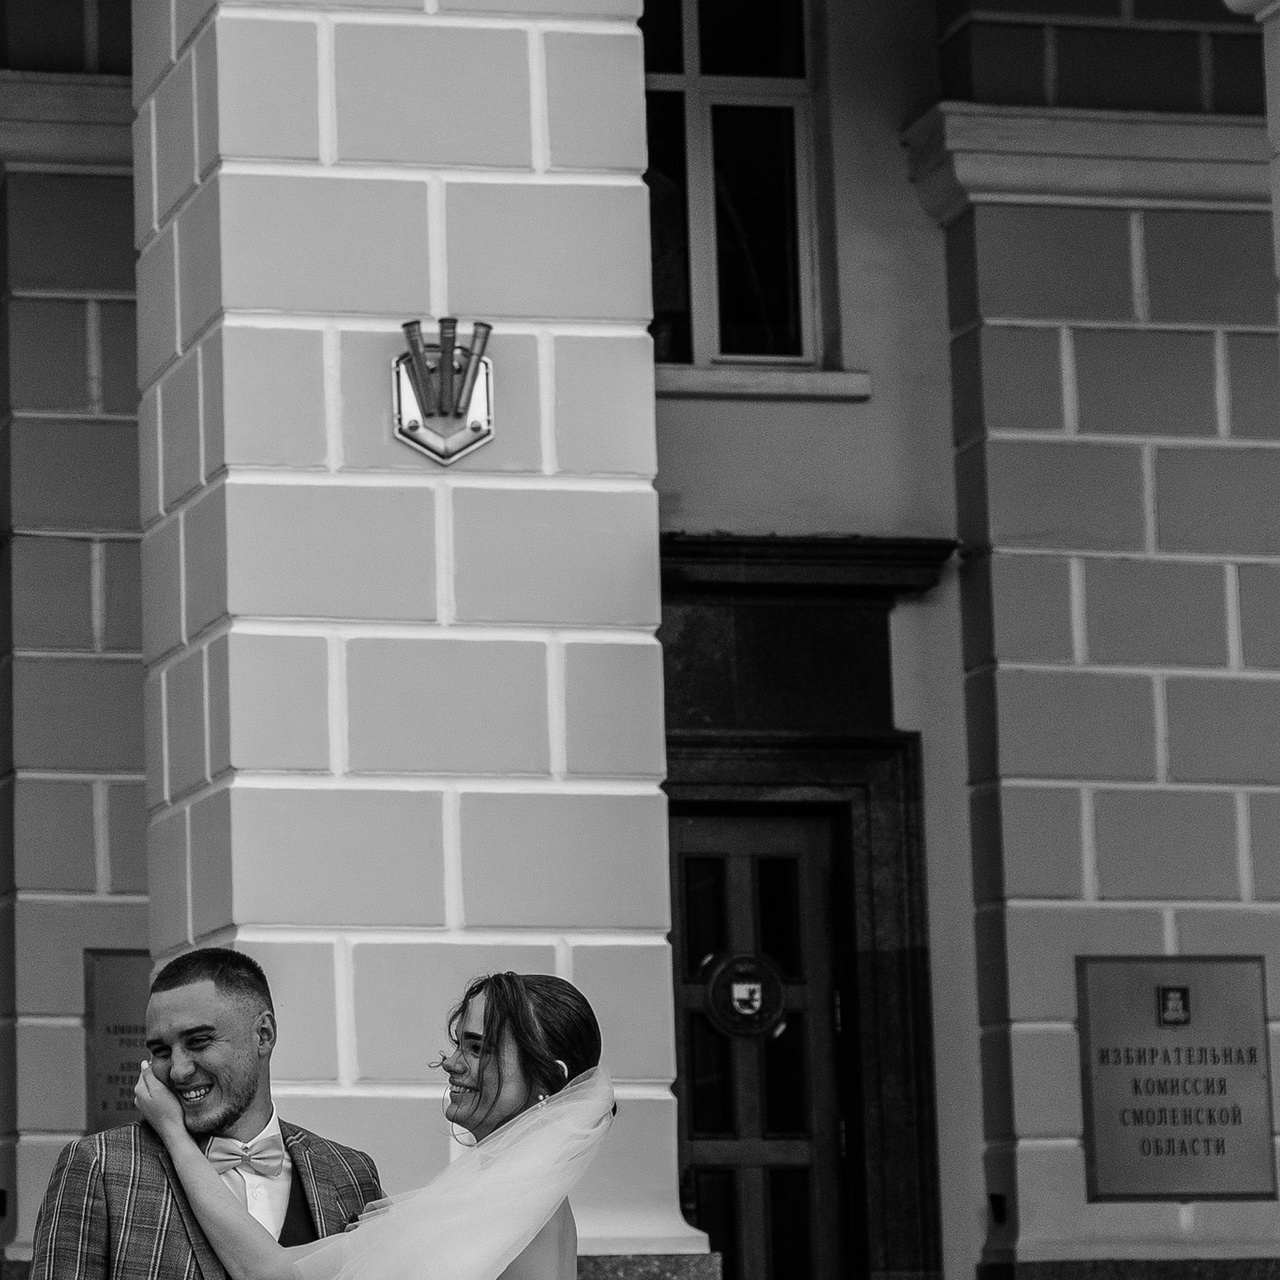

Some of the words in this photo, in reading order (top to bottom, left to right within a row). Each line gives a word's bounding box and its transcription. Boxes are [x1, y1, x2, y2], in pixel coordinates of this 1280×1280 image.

[1098, 1046, 1258, 1066] ИЗБИРАТЕЛЬНАЯ
[1132, 1077, 1228, 1097] КОМИССИЯ
[1121, 1104, 1243, 1127] СМОЛЕНСКОЙ
[1140, 1137, 1226, 1156] ОБЛАСТИ
